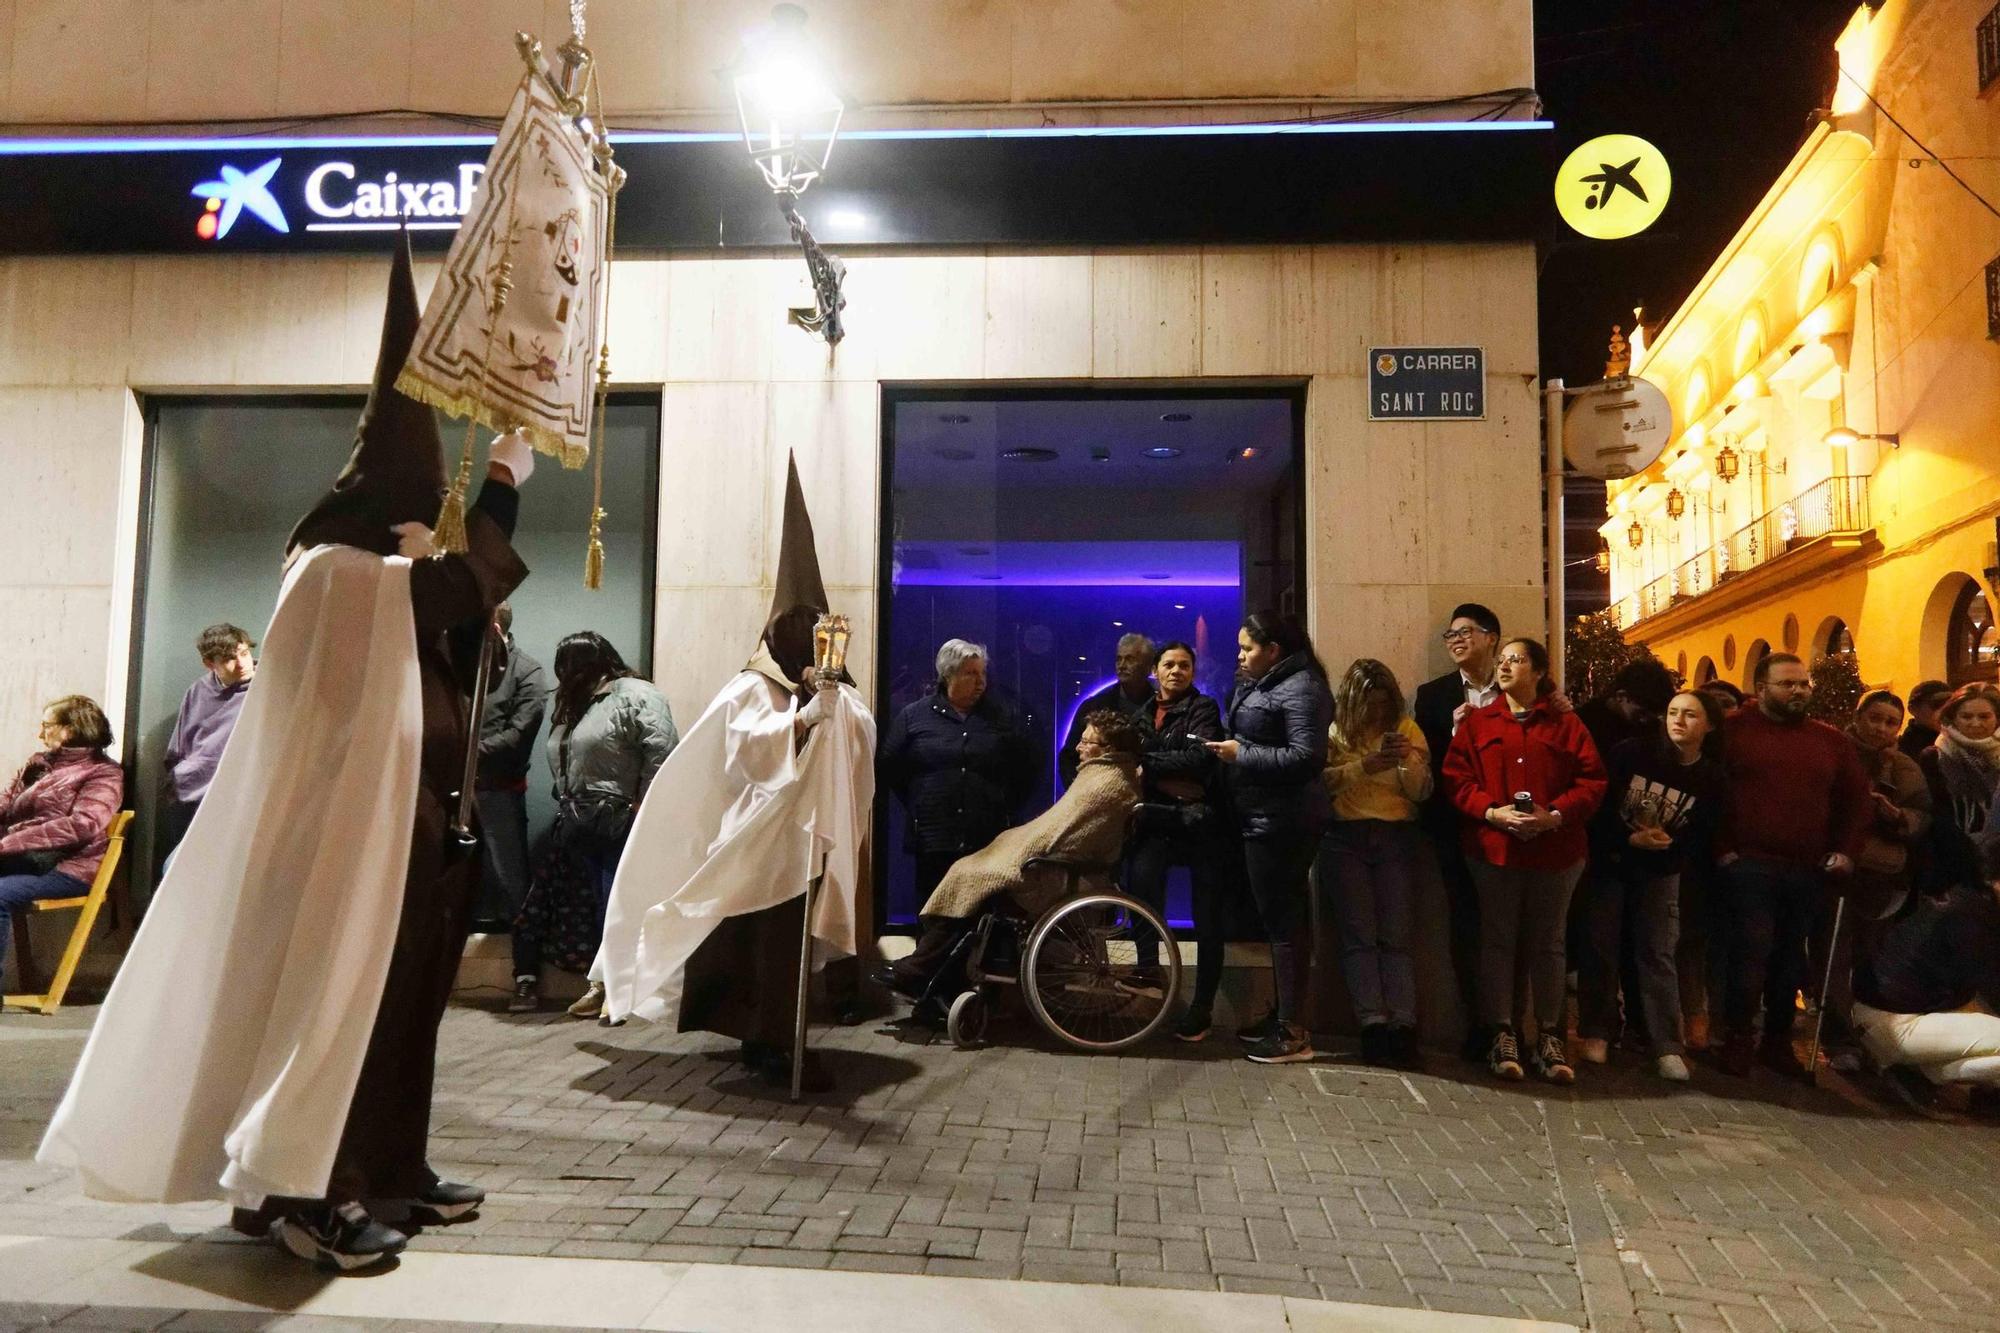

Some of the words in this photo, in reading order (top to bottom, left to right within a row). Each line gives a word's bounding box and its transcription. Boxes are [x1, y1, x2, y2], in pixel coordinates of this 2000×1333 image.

[1403, 355, 1476, 370] CARRER
[1381, 392, 1425, 411] SANT
[1441, 391, 1474, 411] ROC
